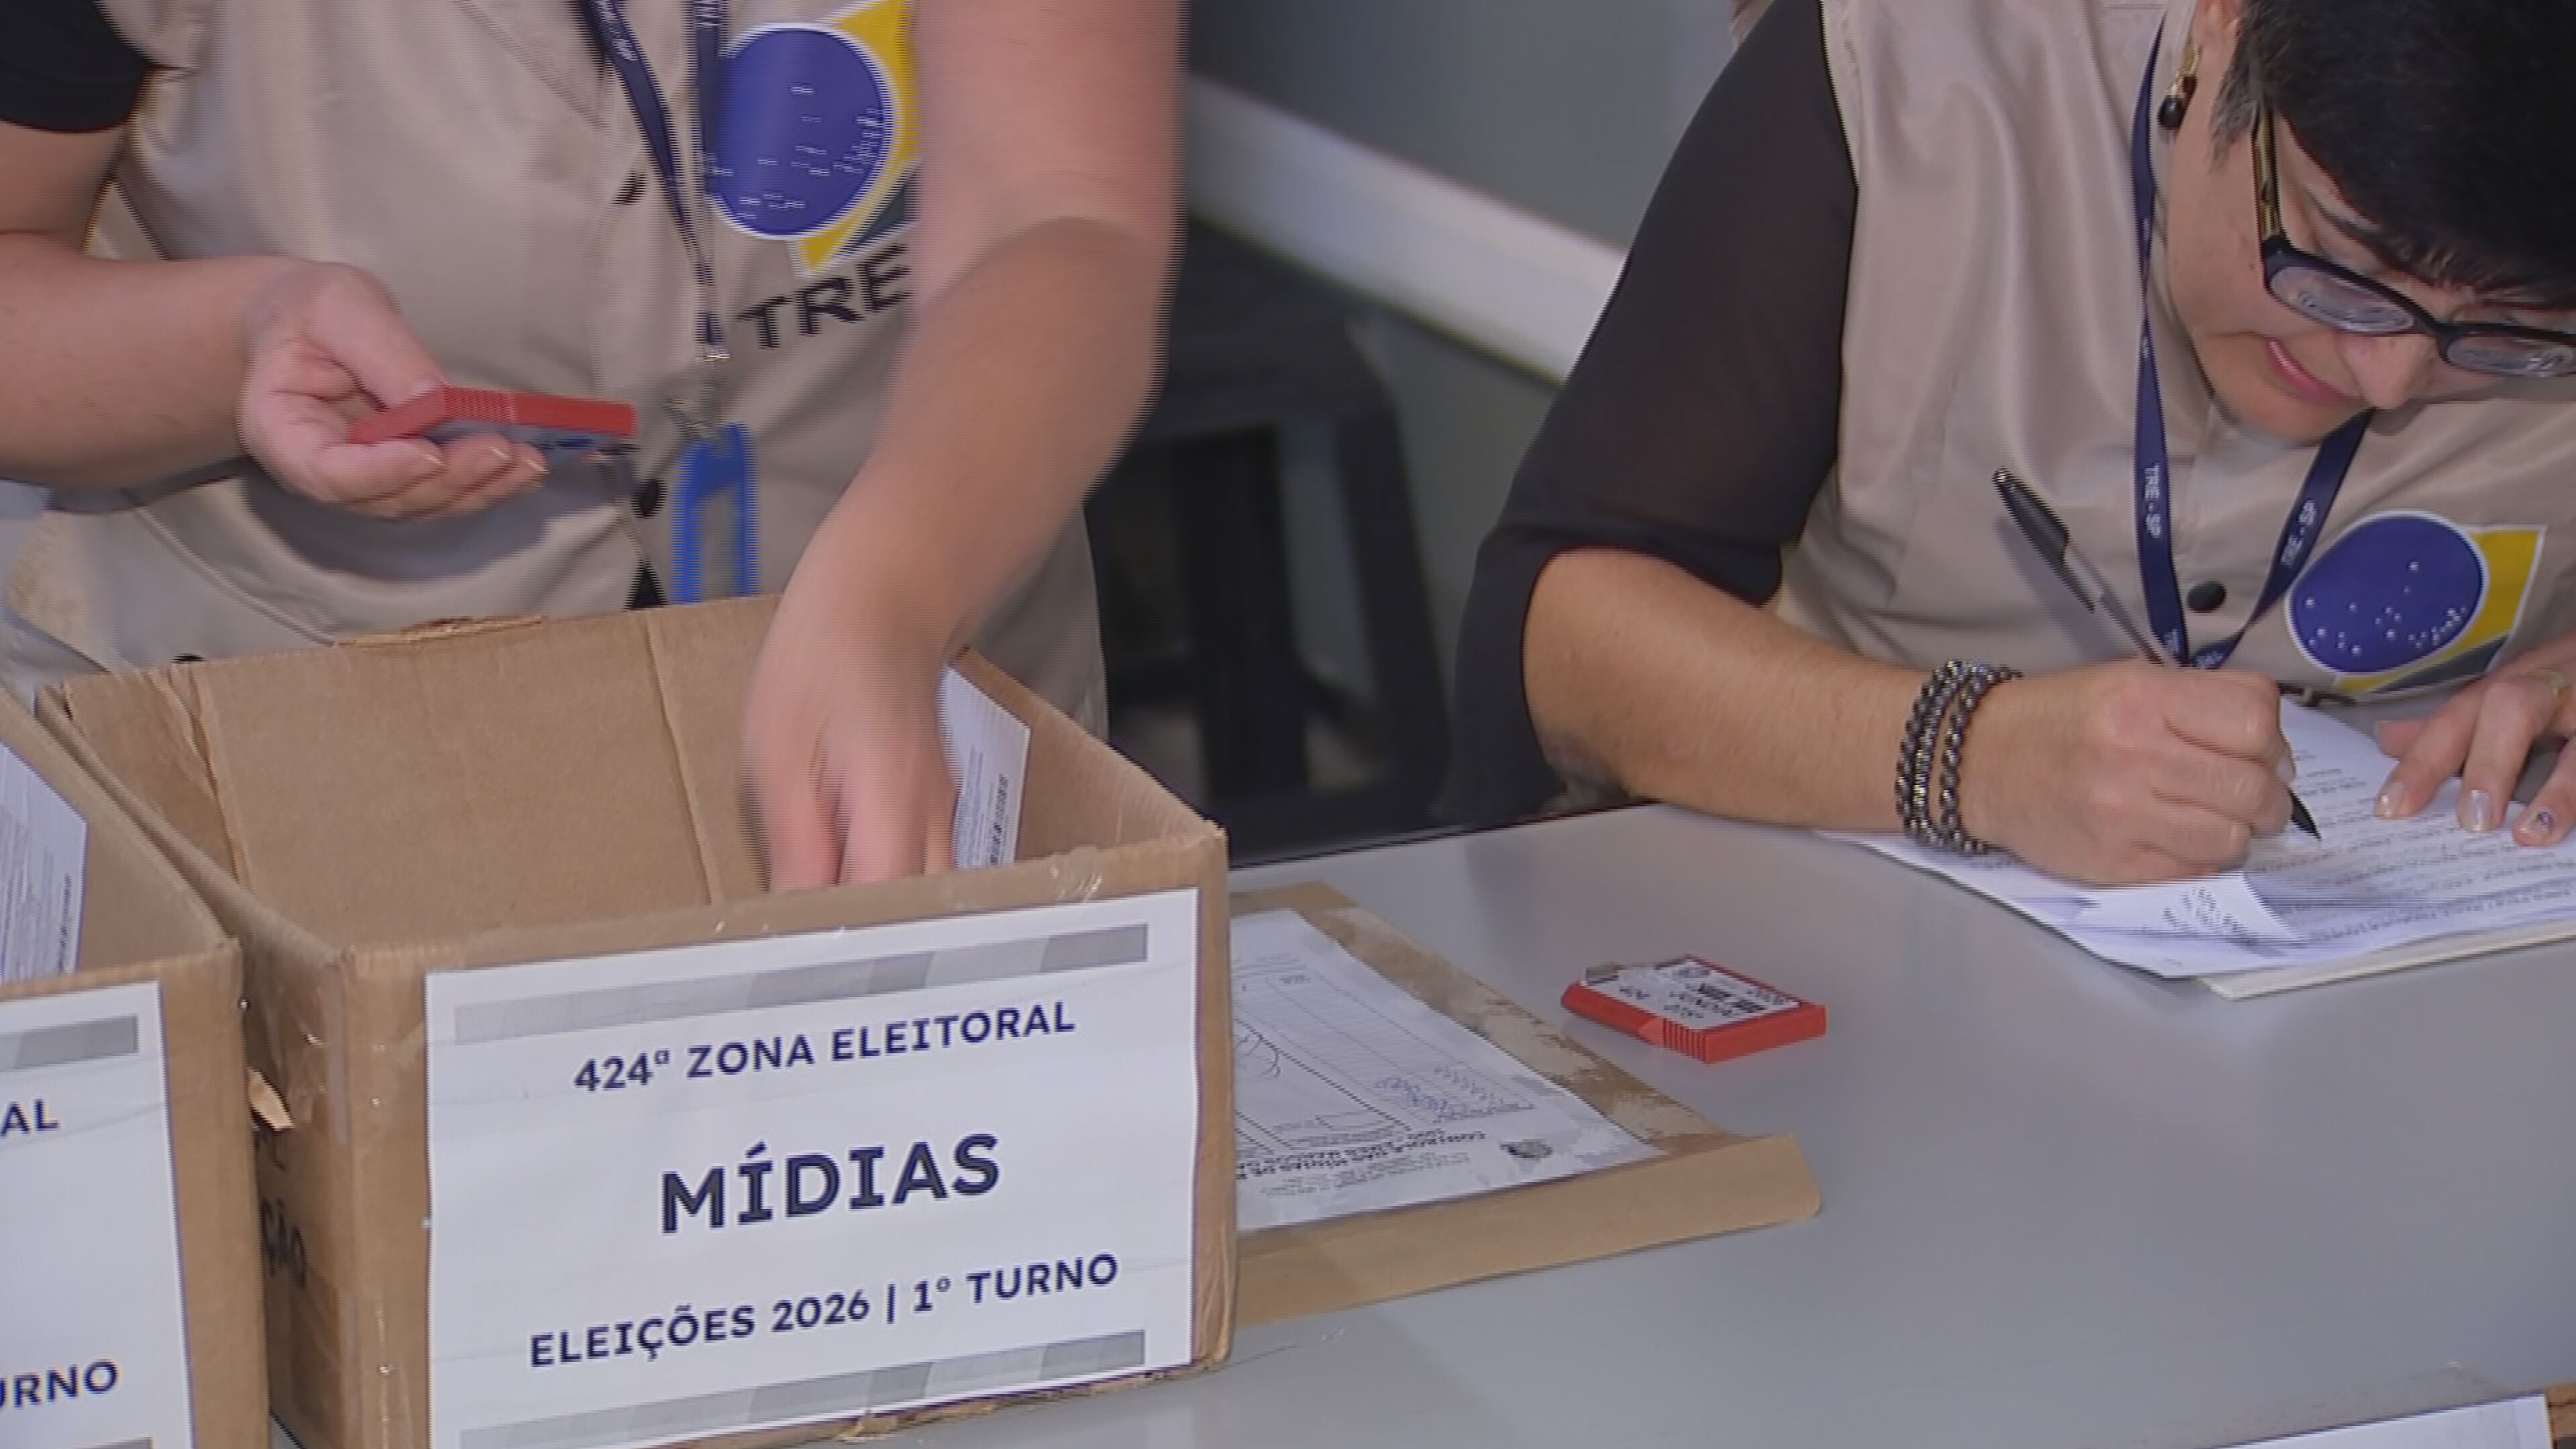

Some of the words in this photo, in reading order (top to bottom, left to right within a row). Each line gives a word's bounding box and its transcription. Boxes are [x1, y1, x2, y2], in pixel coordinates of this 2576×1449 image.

[737, 244, 911, 350] TRE
[2145, 464, 2161, 499] TRE
[2146, 514, 2162, 539] SP
[574, 1049, 669, 1092] 424ª
[687, 1033, 815, 1079] ZONA
[832, 1001, 1076, 1063] ELEITORAL
[660, 1132, 1000, 1234] MÍDIAS
[530, 1295, 756, 1368] ELEIÇÕES
[771, 1290, 871, 1334] 2026
[914, 1277, 951, 1312] 1º
[966, 1253, 1118, 1305] TURNO
